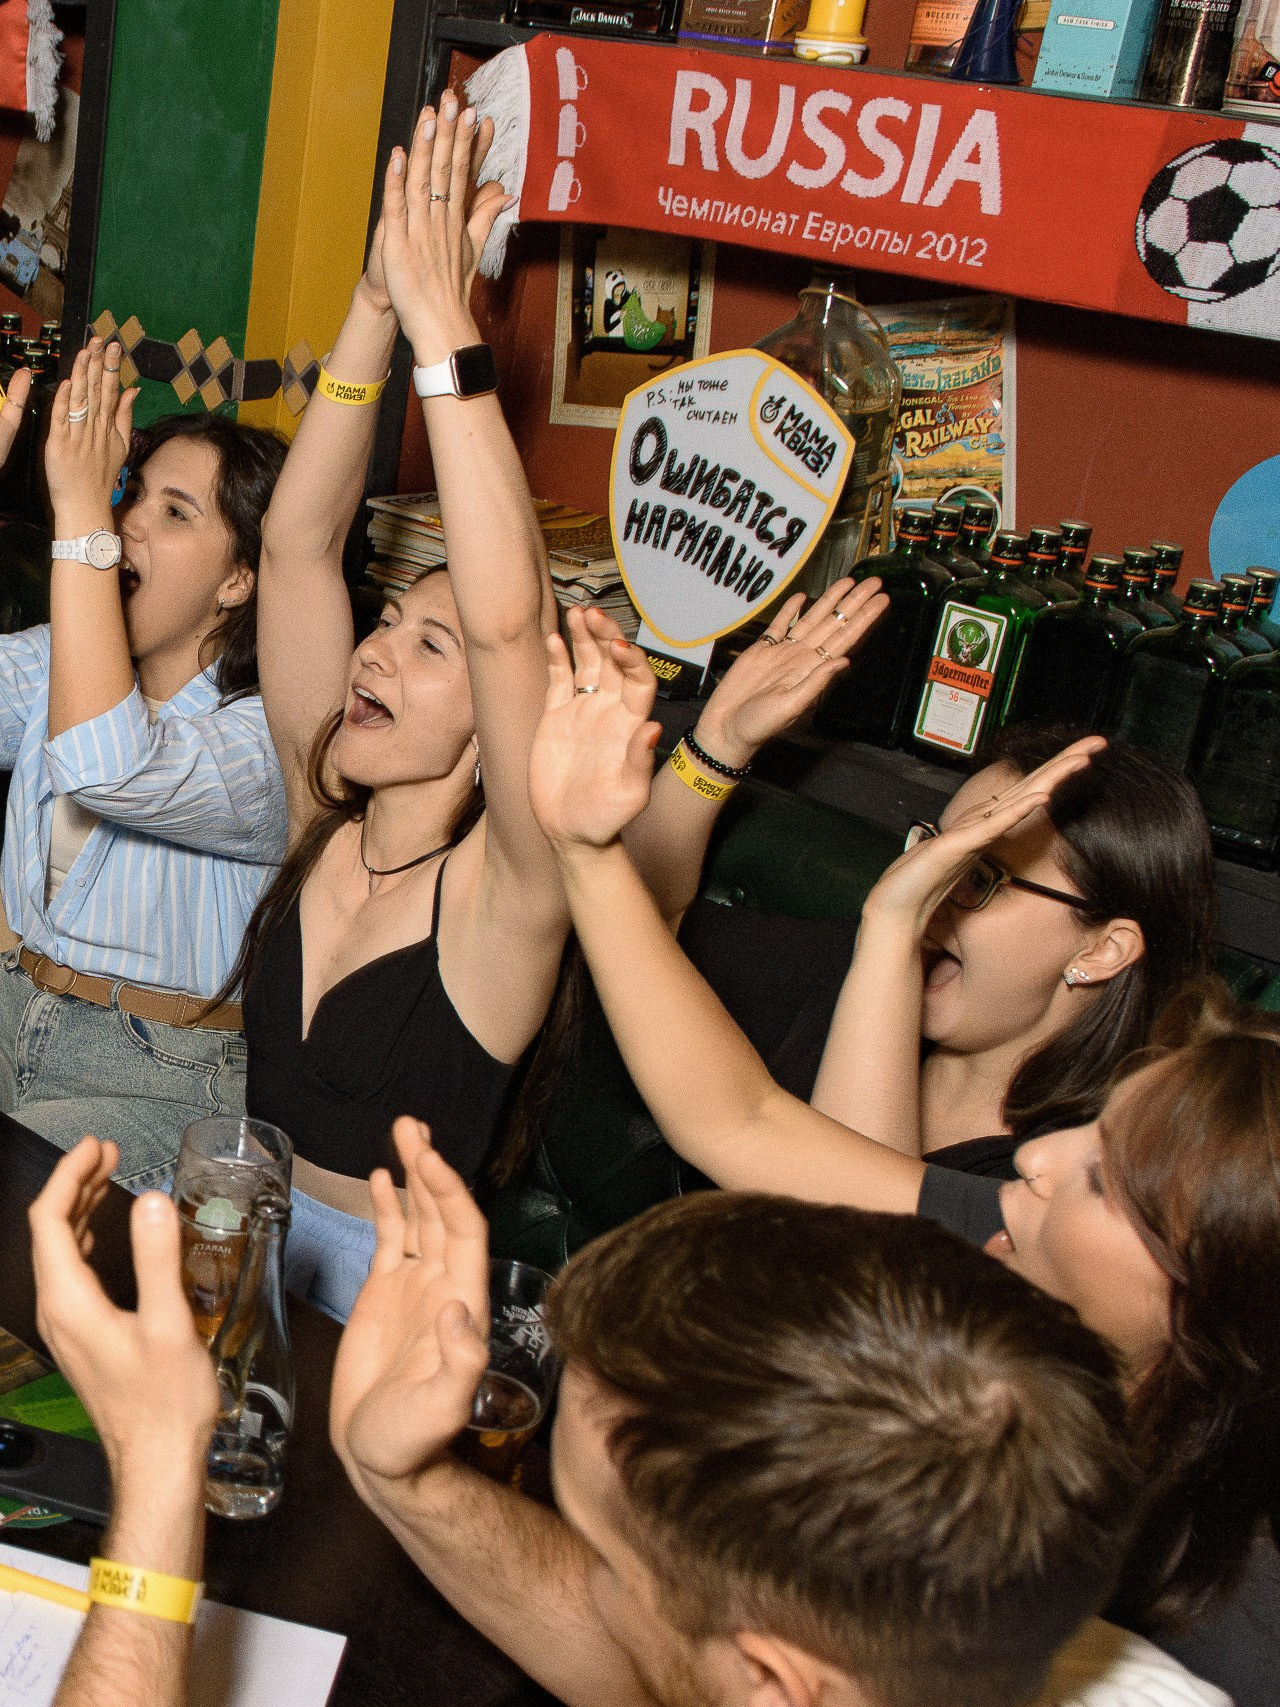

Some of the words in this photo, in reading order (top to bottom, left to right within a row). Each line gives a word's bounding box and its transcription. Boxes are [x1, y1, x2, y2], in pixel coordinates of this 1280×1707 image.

[576, 9, 596, 22] JACK
[667, 70, 1002, 216] RUSSIA
[657, 186, 801, 237] Чемпионат
[802, 211, 911, 258] Европы
[915, 229, 988, 268] 2012
[936, 354, 1002, 393] IRELAND
[335, 391, 366, 401] КВИЗ!
[337, 384, 367, 395] МАМА
[784, 403, 838, 463] МАМА
[904, 418, 995, 458] RAILWAY
[773, 420, 833, 479] КВИЗ!
[647, 655, 682, 673] МАМА
[931, 660, 990, 690] Jägermeister
[948, 690, 960, 703] 56
[693, 781, 721, 797] МАМА
